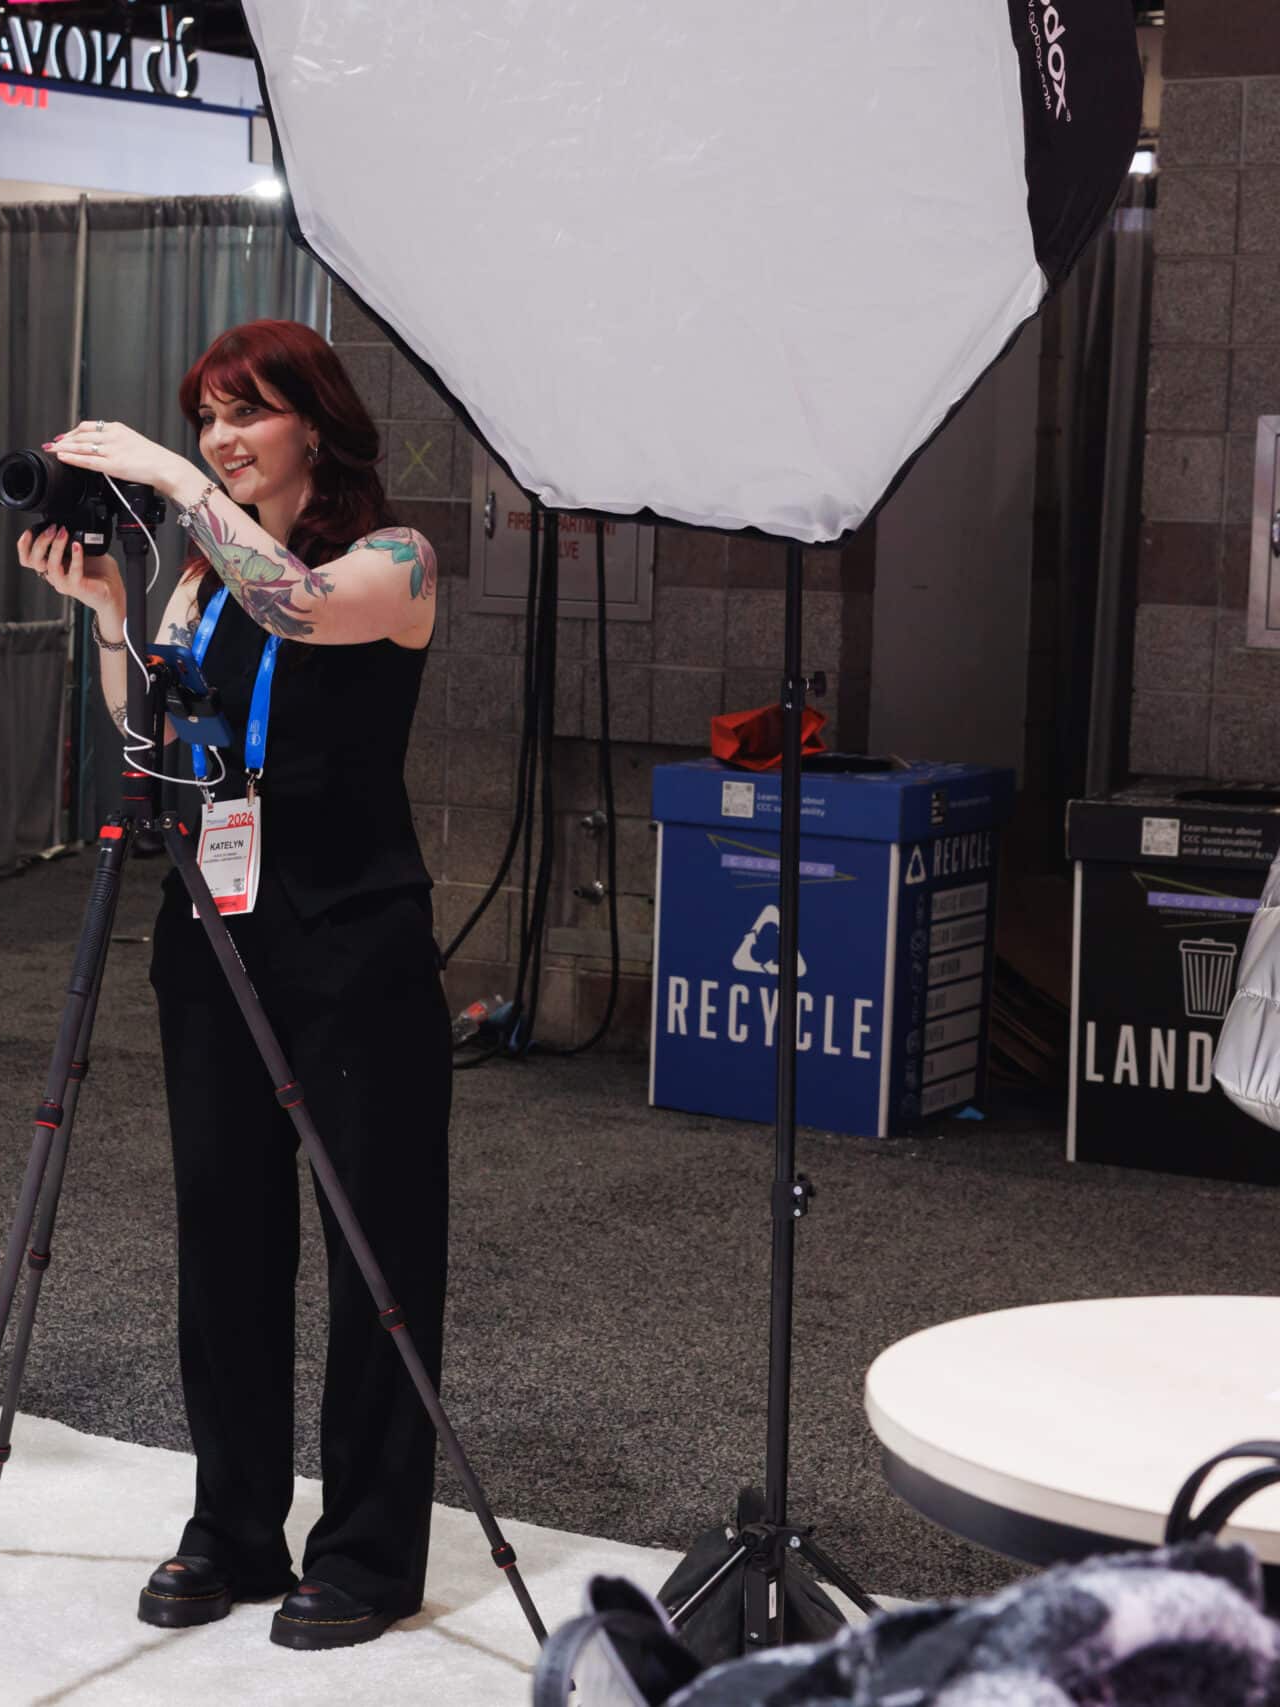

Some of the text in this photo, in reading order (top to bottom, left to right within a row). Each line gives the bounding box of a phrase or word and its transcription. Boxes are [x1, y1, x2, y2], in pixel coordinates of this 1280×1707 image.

[1041, 0, 1067, 119] dox
[227, 811, 255, 828] 2026
[1183, 823, 1263, 837] Learn more about
[209, 840, 245, 852] KATELYN
[1182, 834, 1200, 844] CCC
[933, 831, 992, 878] RECYCLE
[1157, 894, 1256, 911] COLORAD
[666, 975, 874, 1060] RECYCLE
[1085, 1020, 1214, 1094] LAND
